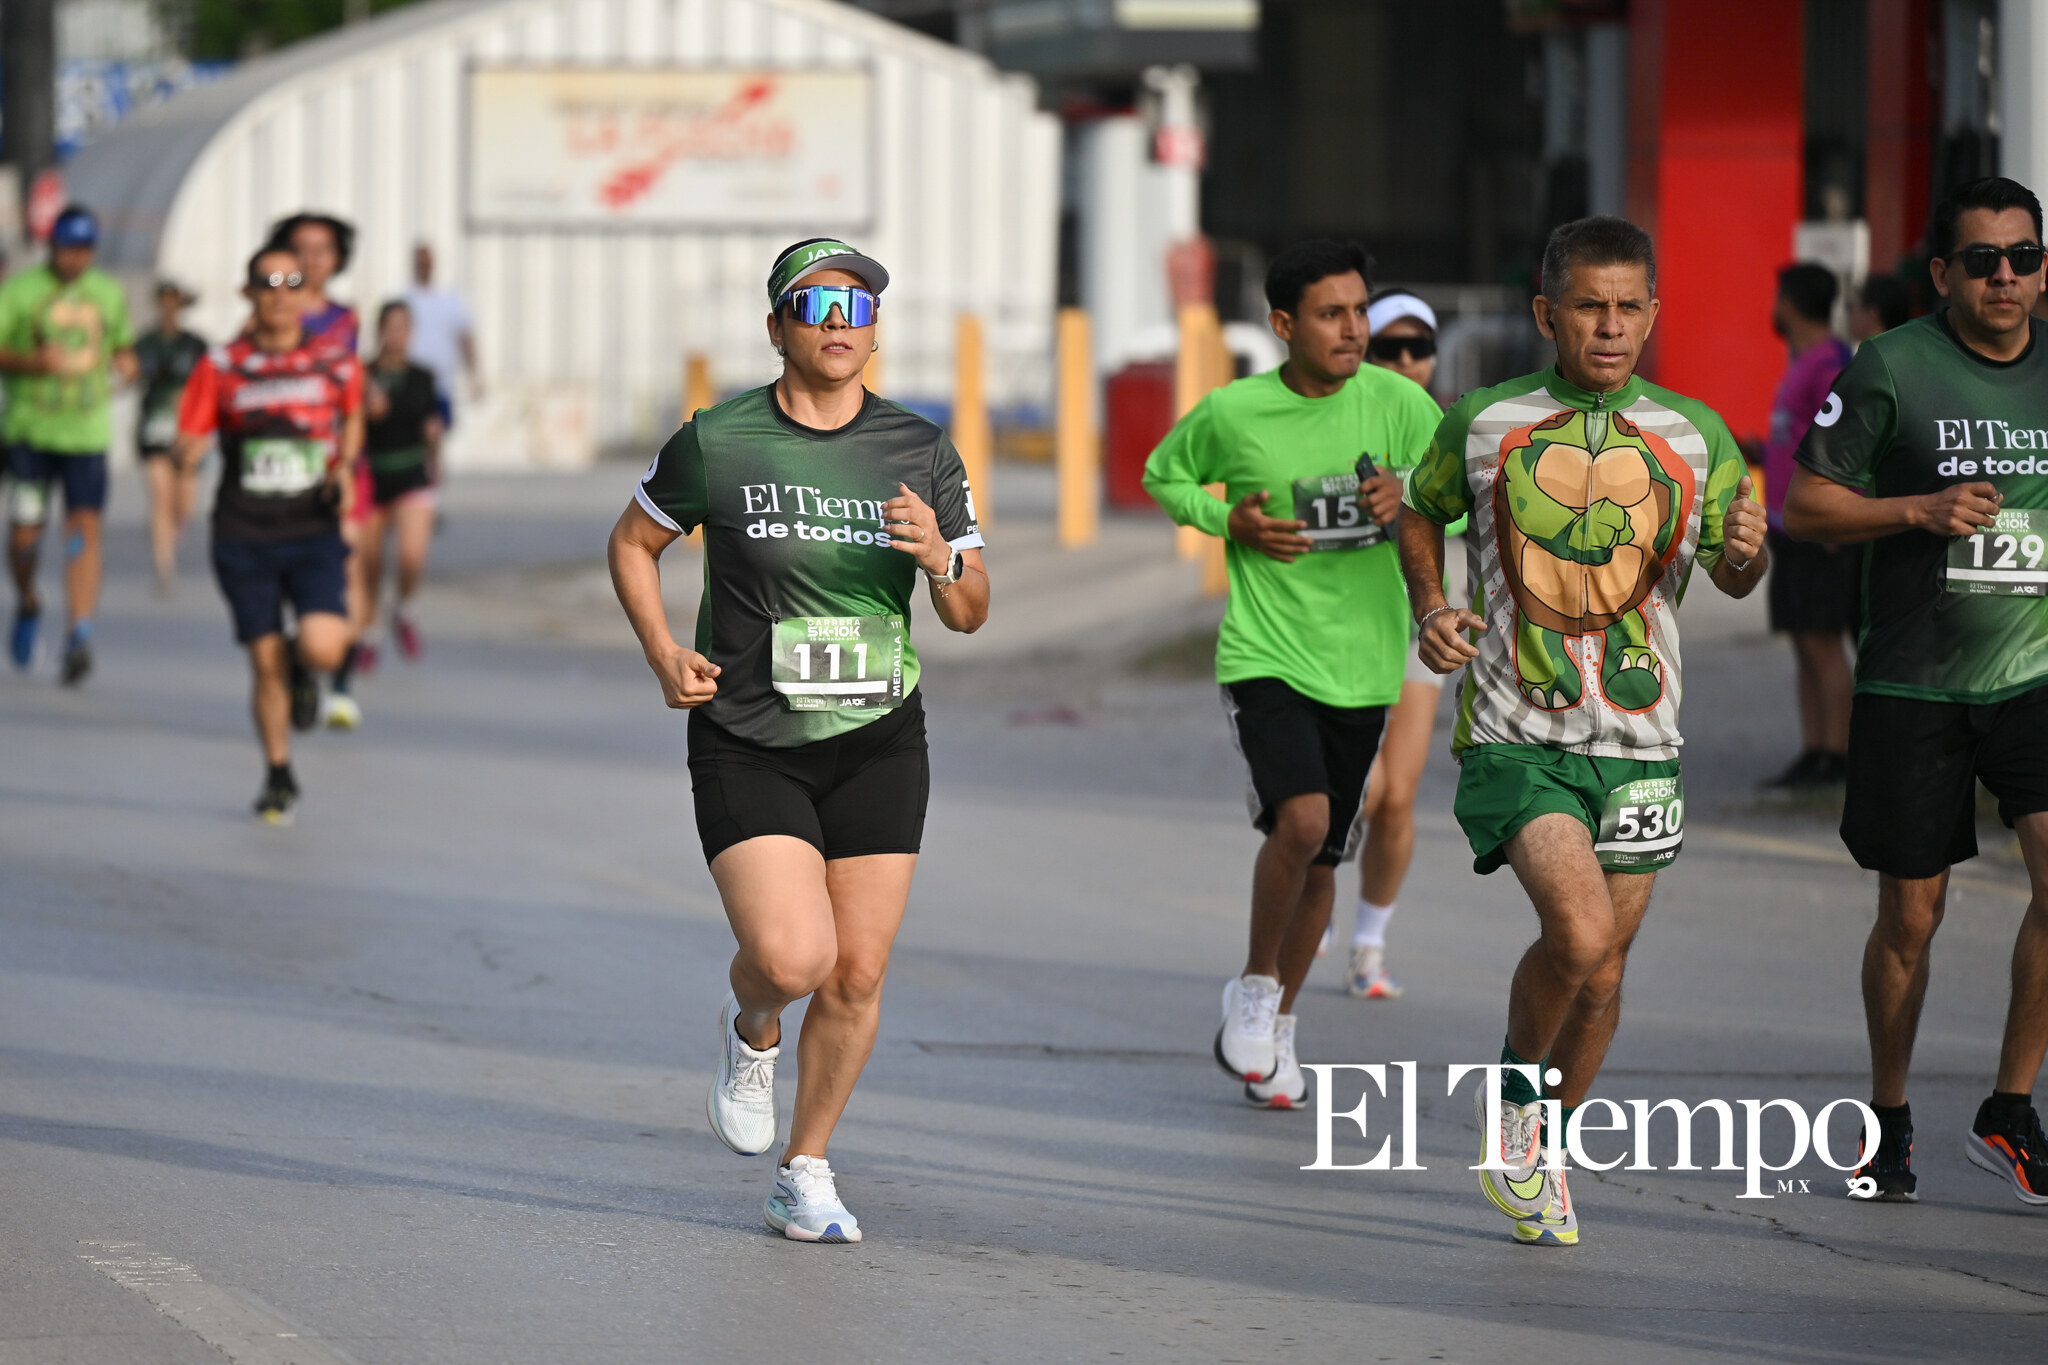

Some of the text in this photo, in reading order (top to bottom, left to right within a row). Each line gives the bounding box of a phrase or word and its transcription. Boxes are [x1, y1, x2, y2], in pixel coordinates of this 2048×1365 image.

[1933, 418, 1975, 451] El
[1937, 456, 1979, 477] de
[739, 483, 909, 530] El Tiemp
[1310, 495, 1362, 529] 15
[746, 518, 893, 549] de todos
[1967, 533, 2046, 569] 129
[807, 618, 861, 627] CARRERA
[792, 642, 868, 681] 111
[892, 635, 902, 698] MEDALLA
[1629, 778, 1677, 790] CARRERA
[1614, 798, 1682, 841] 530
